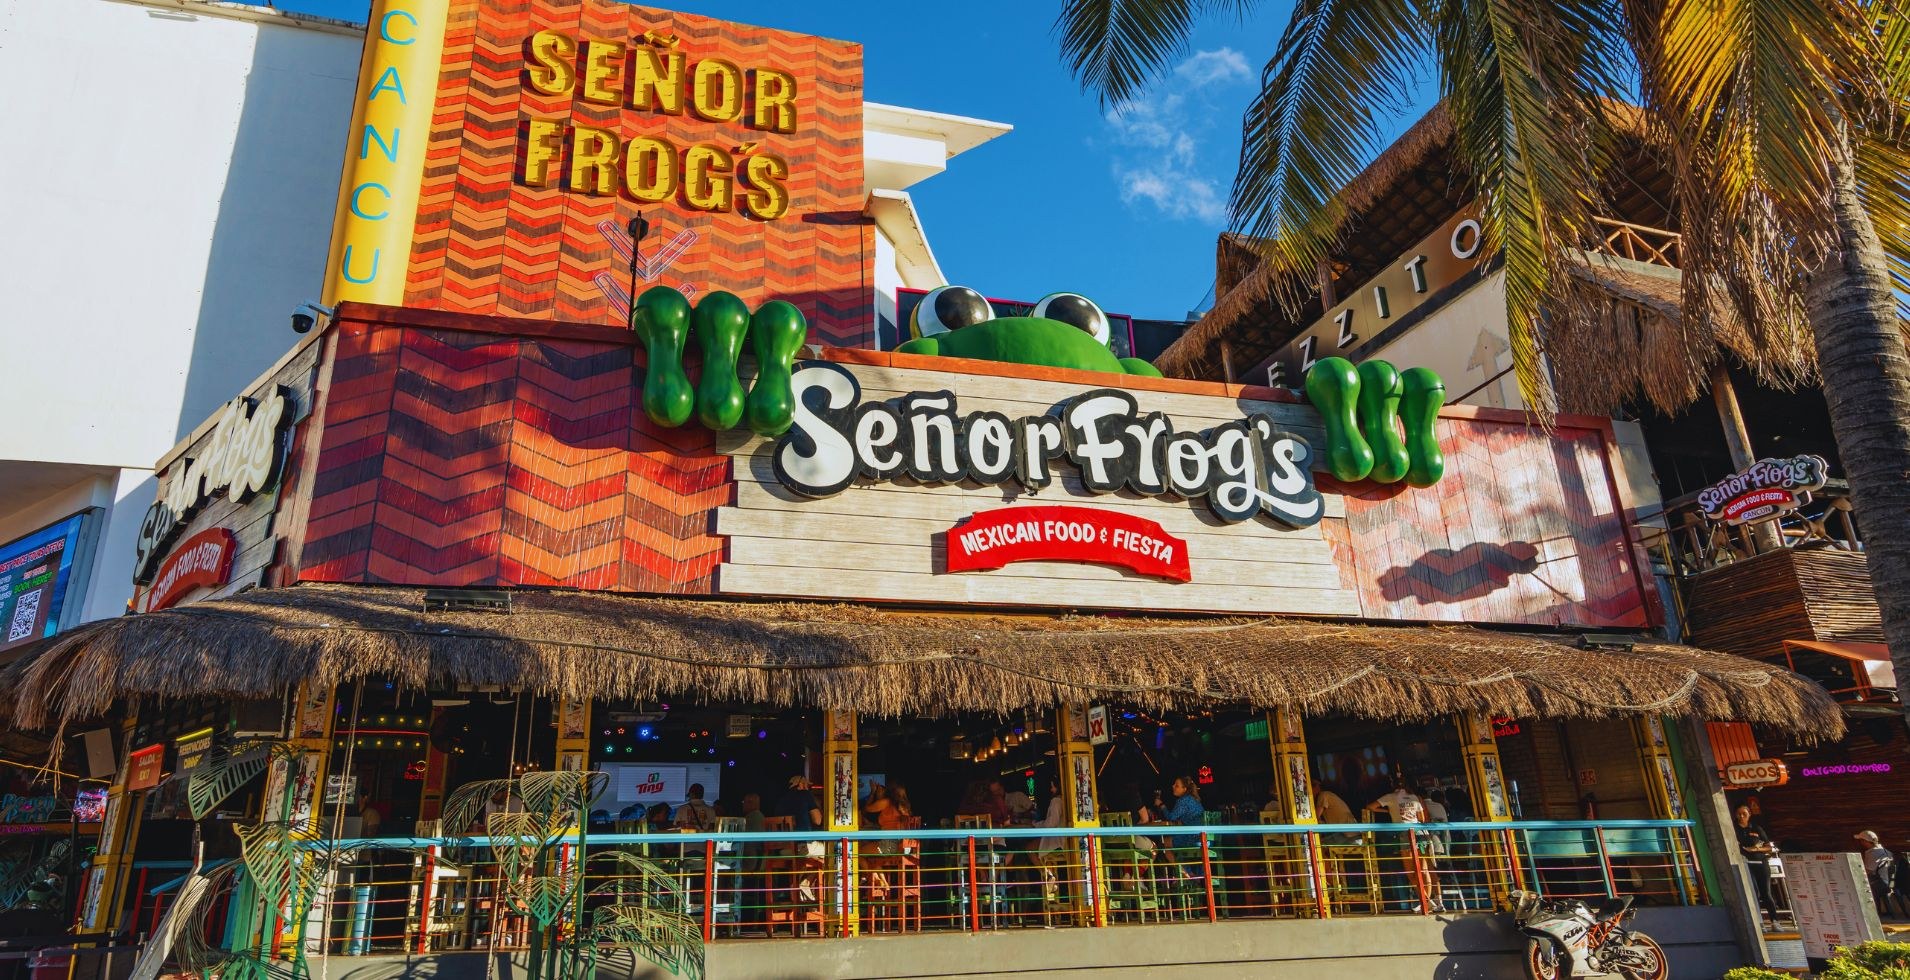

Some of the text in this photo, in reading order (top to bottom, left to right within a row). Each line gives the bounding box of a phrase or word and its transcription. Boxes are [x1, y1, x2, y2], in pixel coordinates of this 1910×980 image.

[529, 29, 798, 135] SEÑOR
[342, 9, 417, 285] CANCU
[525, 116, 789, 221] FROG'S
[780, 366, 1319, 519] Señor Frog's
[1698, 459, 1810, 513] Señor Frog's
[1747, 495, 1760, 506] FOOD
[1765, 492, 1783, 501] FIESTA
[960, 521, 1041, 556] MEXICAN
[1044, 521, 1096, 543] FOOD
[1113, 528, 1173, 565] FIESTA
[176, 546, 197, 580] FOOD
[1089, 717, 1104, 738] XX
[1728, 766, 1777, 781] TACOS
[1823, 765, 1846, 775] GOOD
[636, 781, 665, 794] Ting
[1563, 926, 1583, 942] KTM
